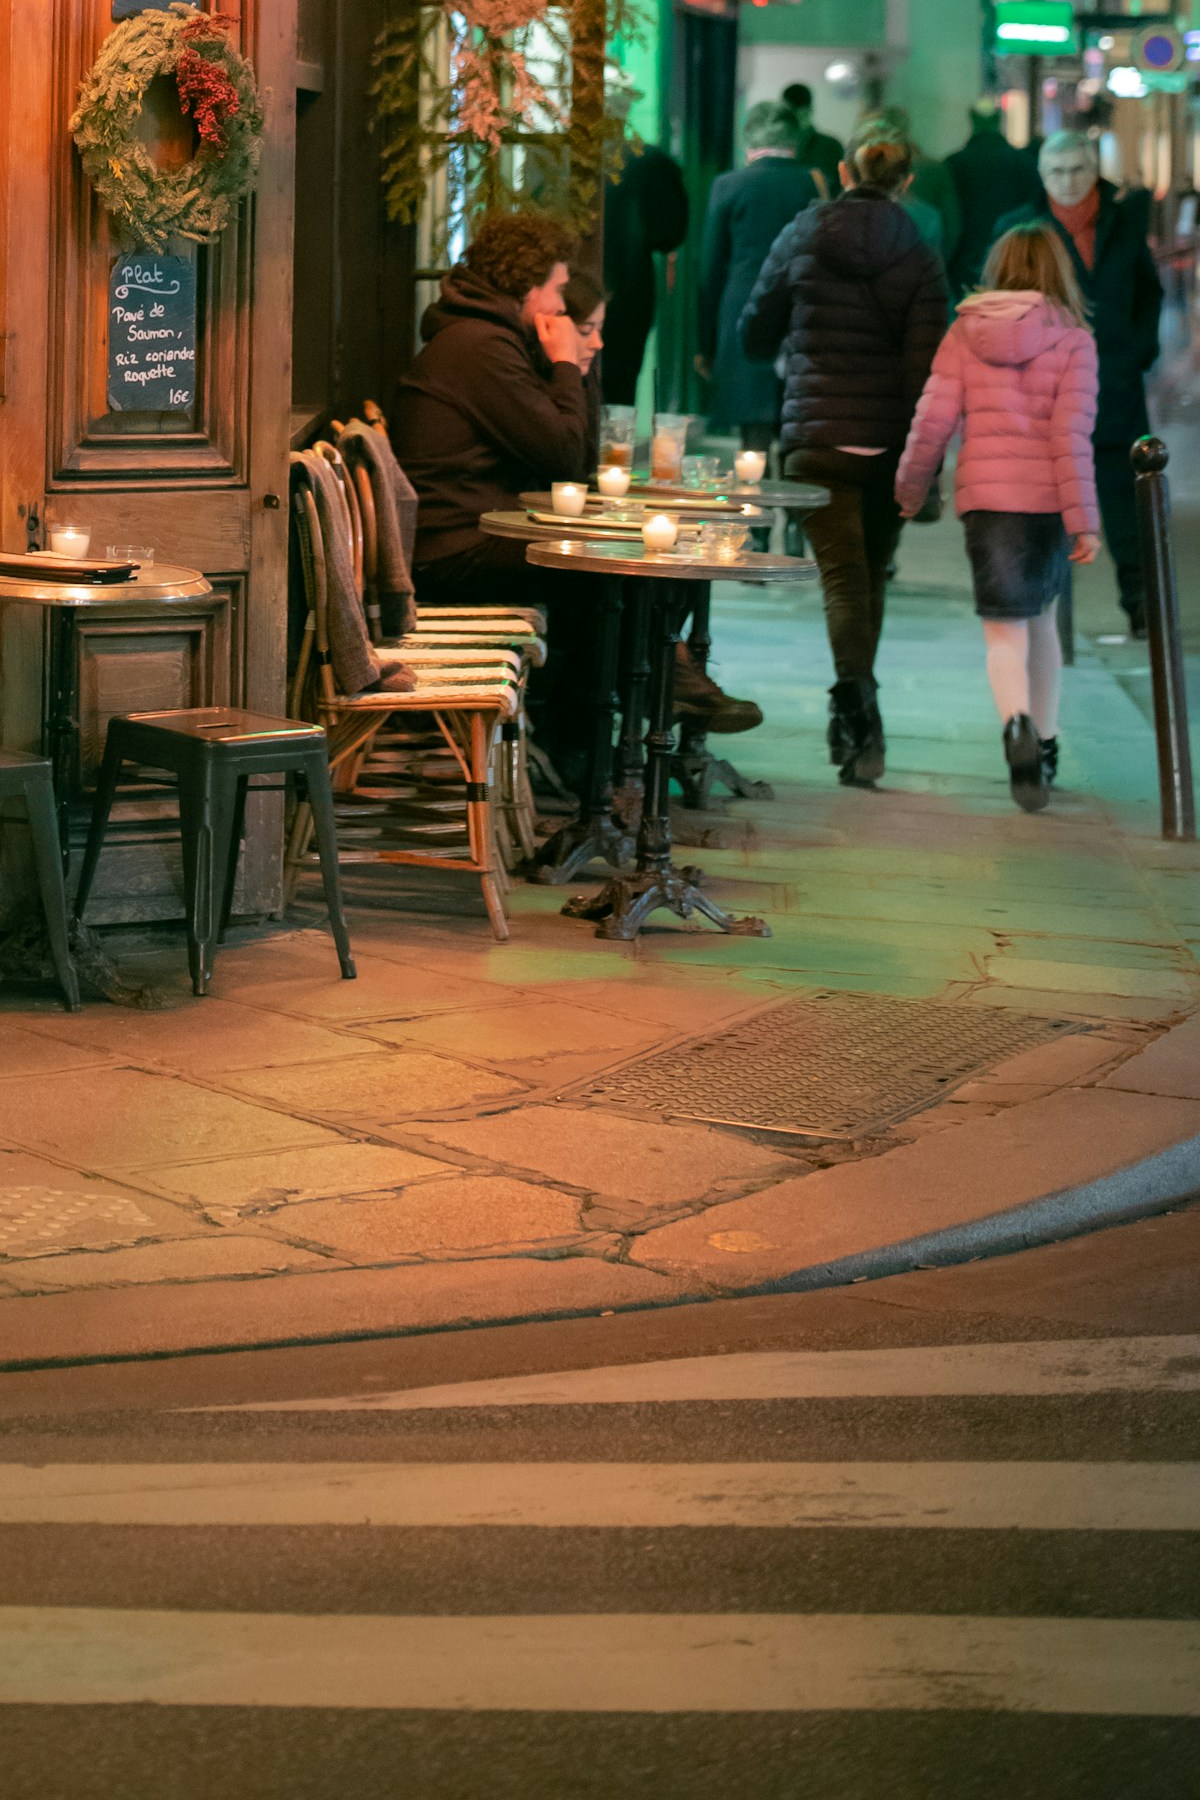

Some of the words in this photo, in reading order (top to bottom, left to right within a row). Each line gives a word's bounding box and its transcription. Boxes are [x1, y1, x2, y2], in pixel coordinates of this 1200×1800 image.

[122, 263, 164, 284] Plat
[112, 304, 145, 324] Pavé
[149, 302, 165, 318] de
[145, 347, 195, 362] coriandre
[169, 388, 190, 405] 16€
